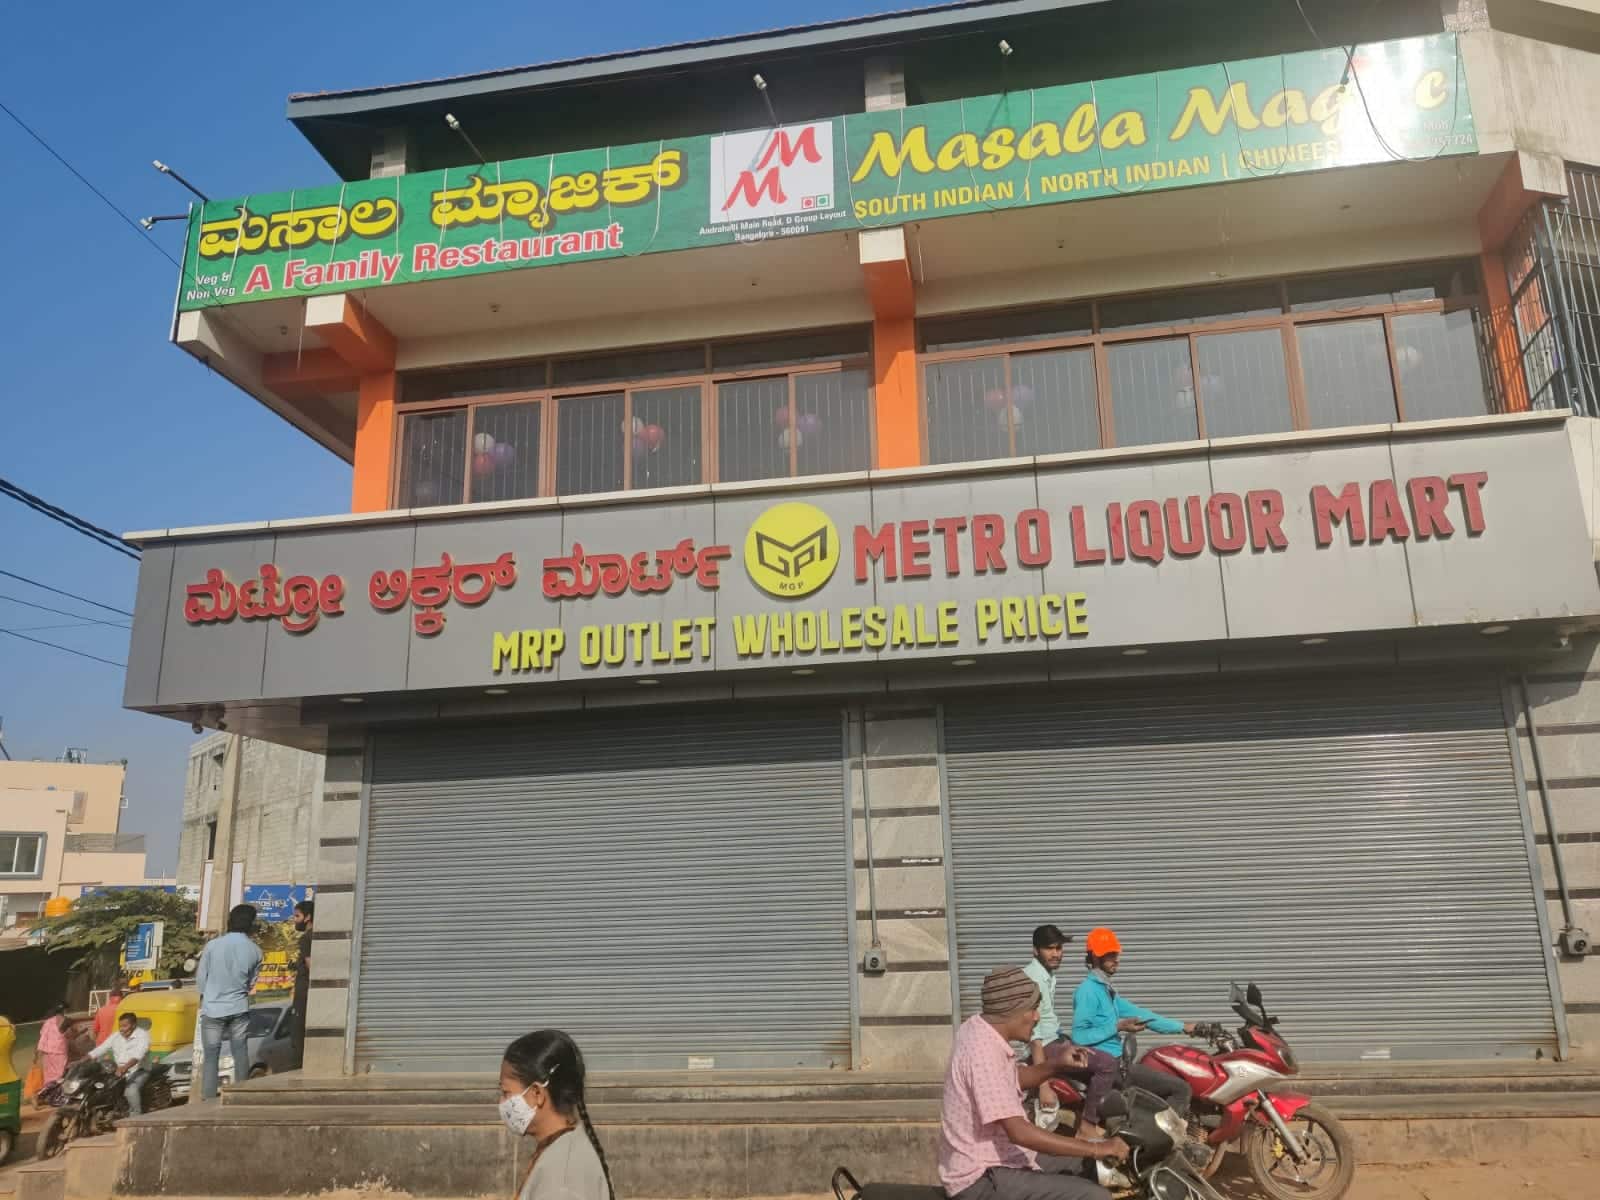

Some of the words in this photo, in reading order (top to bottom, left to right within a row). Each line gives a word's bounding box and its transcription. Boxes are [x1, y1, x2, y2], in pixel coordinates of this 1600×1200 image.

[852, 103, 1146, 184] Masala
[1169, 70, 1448, 142] Magc
[431, 150, 682, 229] ಮ್ಯಾಜಿಕ್
[740, 220, 760, 230] Main
[794, 212, 818, 224] Group
[820, 209, 847, 221] Layout
[854, 194, 926, 220] SOUTH
[934, 181, 1014, 208] INDIAN
[1040, 169, 1118, 195] NORTH
[1126, 153, 1211, 183] INDIAN
[243, 264, 273, 294] A
[283, 248, 401, 289] Family
[412, 222, 624, 273] Restaurant
[781, 224, 809, 236] 560091
[197, 274, 218, 286] Veg
[214, 286, 236, 297] Veg
[854, 508, 1052, 583] METRO
[1071, 489, 1288, 566] LIQUOR
[1311, 472, 1489, 547] MART
[184, 563, 345, 633] ಮೆಟ್ರೋ
[368, 551, 517, 636] ಲಿಕ್ಕರ್
[492, 628, 566, 673] MRP
[578, 616, 718, 666] OUTLET
[732, 600, 960, 657] WHOLESALE
[976, 592, 1090, 641] PRICE
